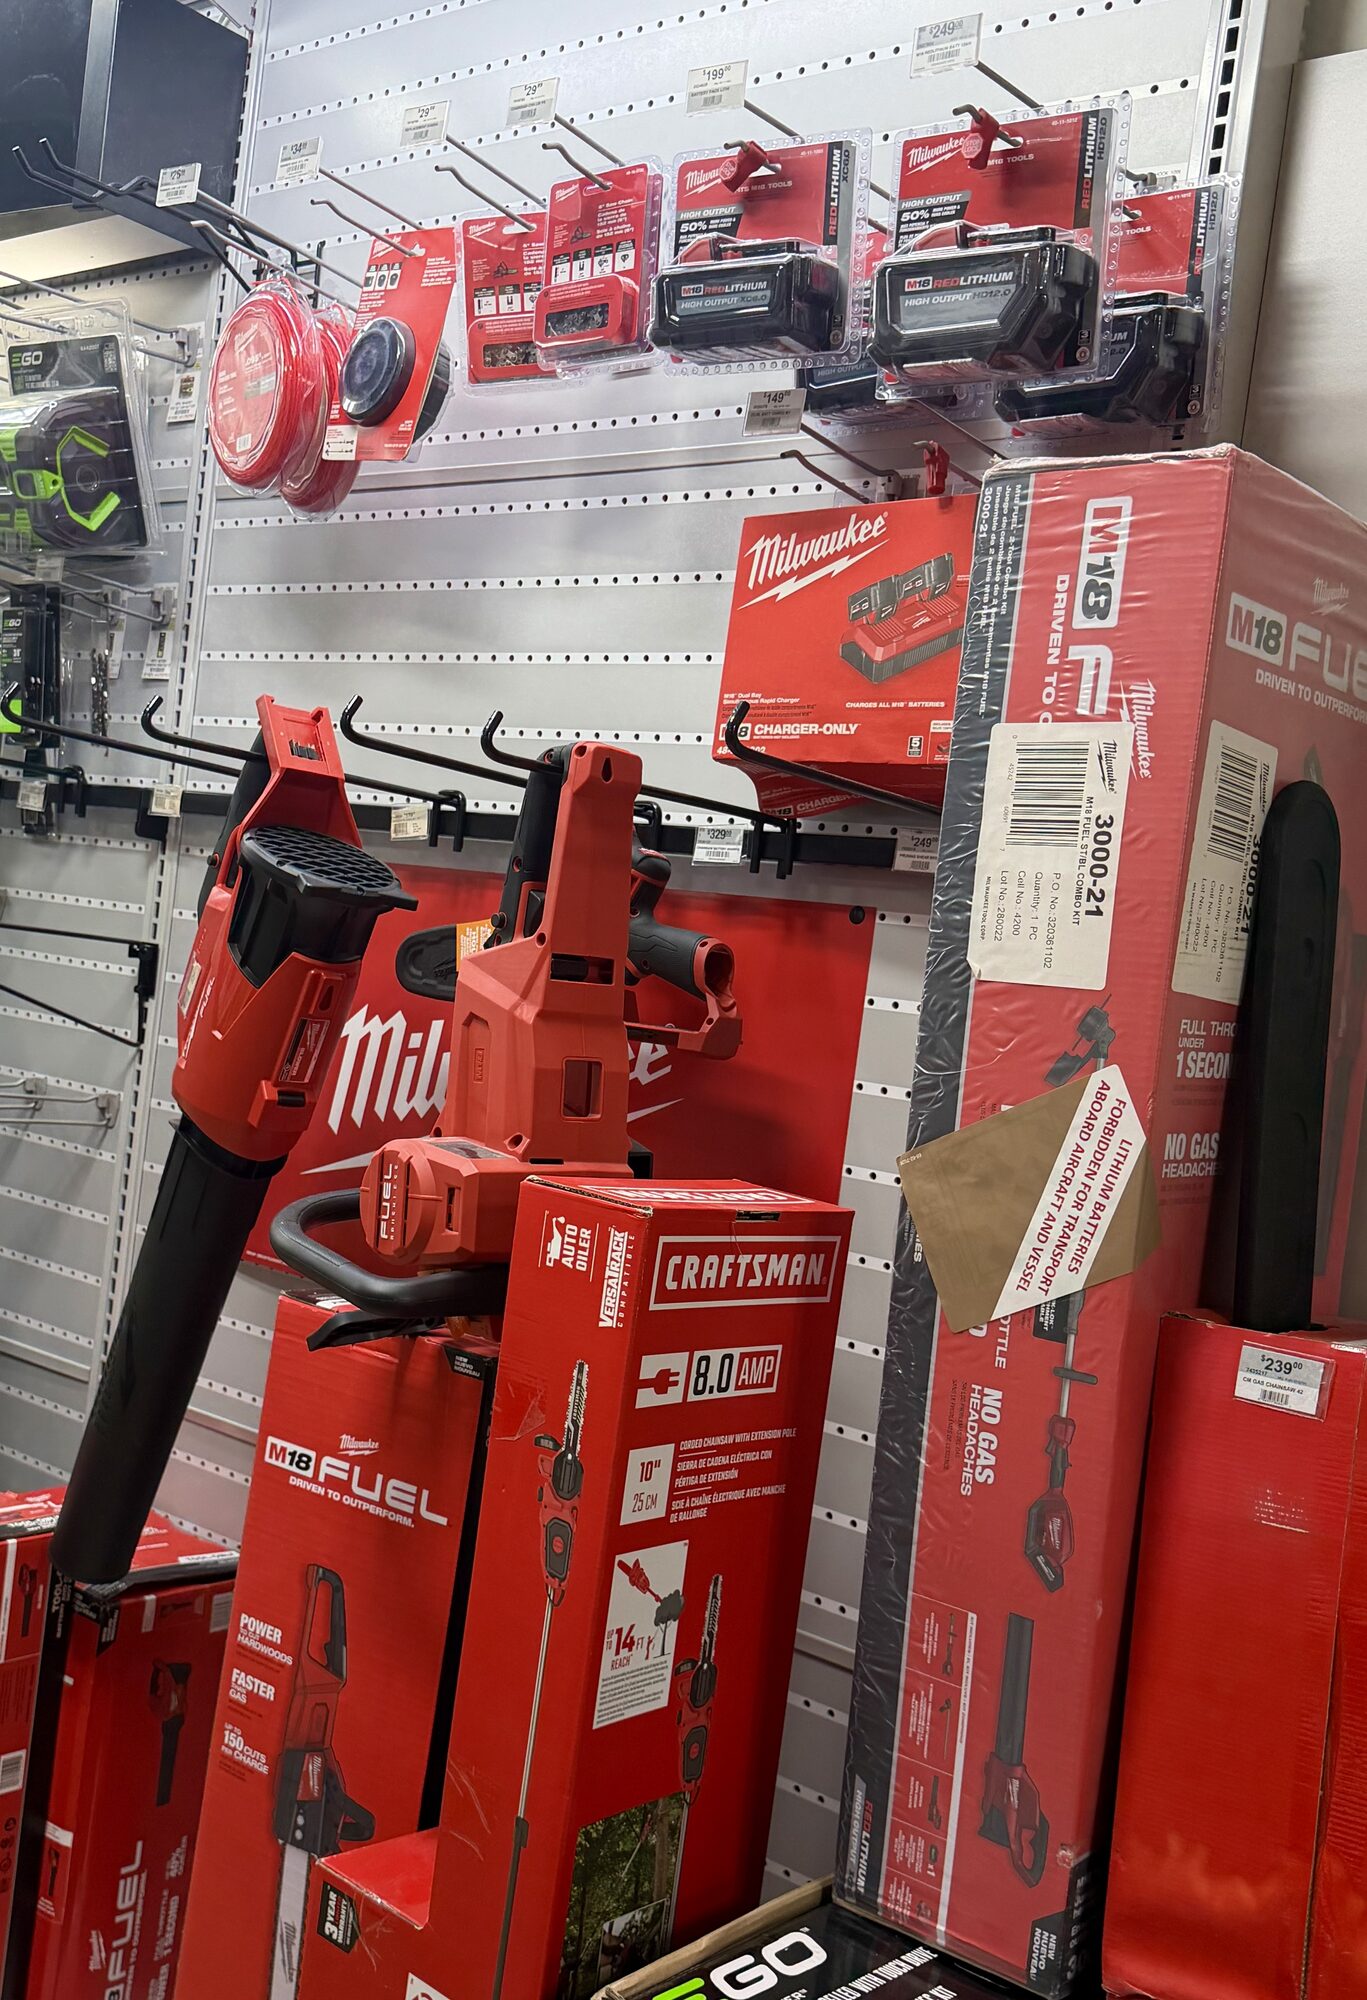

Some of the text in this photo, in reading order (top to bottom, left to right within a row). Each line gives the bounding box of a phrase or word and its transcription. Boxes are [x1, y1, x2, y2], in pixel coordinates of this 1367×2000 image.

[1007, 154, 1034, 163] TOOLS
[1081, 117, 1098, 209] REDLITHIUM
[768, 180, 793, 189] TOOLS
[829, 148, 841, 235] REDLITHIUM
[901, 193, 962, 209] HIGH OUTPUT
[680, 206, 736, 219] HIGH OUTPUT
[680, 221, 708, 232] 50%
[901, 210, 929, 221] 50%
[1126, 226, 1152, 236] TOOLS
[1193, 191, 1210, 276] REDLITHIUM
[703, 281, 767, 296] REDLITHIUM
[907, 272, 1013, 290] M18 REDLITHIUM
[681, 297, 738, 309] HIGH OUTPUT
[905, 297, 930, 307] HIGH
[932, 293, 971, 305] OUTPUT
[11, 351, 43, 368] EGO
[978, 486, 993, 539] 3000-21
[1002, 485, 1012, 515] Juego
[985, 486, 1003, 583] Ensemble outils
[1001, 516, 1009, 529] de
[744, 513, 888, 591] Milwaukee
[996, 531, 1007, 582] combinado
[1081, 505, 1124, 621] M18
[1000, 536, 1016, 615] 2-Tool Combo Kit
[1042, 574, 1070, 705] DRIVEN TO
[1230, 604, 1283, 656] M18
[1255, 668, 1312, 702] DRIVEN TO
[754, 723, 858, 736] CHARGER-ONLY
[1130, 678, 1157, 779] Milwaukee
[1103, 739, 1117, 794] Milwaukee
[1000, 870, 1009, 885] Lot
[1072, 796, 1094, 926] M18 FUEL ST/BL COMBO KIT
[1086, 814, 1114, 917] 3000-21
[1011, 870, 1027, 936] Cell 4200
[1028, 871, 1044, 941] Quantity: PC
[1236, 889, 1246, 925] COMBO
[1178, 1037, 1204, 1049] UNDER
[1180, 1019, 1207, 1036] FULL
[1176, 1051, 1185, 1078] 1
[1083, 1097, 1128, 1181] FORBIDDEN
[1164, 1132, 1220, 1160] NO GAS
[380, 1163, 393, 1240] FUEL
[1016, 1080, 1112, 1293] ABOARD AIRCRAFT AND VESSEL
[1071, 1182, 1093, 1213] FOR
[1067, 1139, 1134, 1276] LITHIUM BATTERIES
[561, 1224, 578, 1270] AUTO
[575, 1227, 592, 1272] OILER
[1038, 1212, 1080, 1296] TRANSPORT
[599, 1228, 629, 1328] VERSATRACK
[617, 1234, 635, 1328] COMPATIBLE
[665, 1253, 825, 1291] CRAFTSMAN
[693, 1352, 775, 1397] 8.0 AMP
[1252, 1378, 1296, 1394] GAS CHAINSAW
[338, 1434, 380, 1450] Milwaukee
[679, 1428, 797, 1451] CORDED CHAINSAW WITH EXTENSION POLE
[960, 1384, 983, 1497] HEADACHES
[975, 1386, 1003, 1485] NO GAS
[676, 1459, 698, 1472] SIERRA
[706, 1454, 729, 1468] CADENA
[760, 1449, 773, 1460] CON
[267, 1442, 448, 1526] M18 FUEL
[289, 1475, 325, 1496] DRIVEN
[327, 1488, 341, 1502] TO
[671, 1498, 685, 1511] SCIE
[745, 1486, 762, 1498] AVEC
[762, 1484, 786, 1496] MANCHE
[632, 1492, 658, 1513] 25 CM
[678, 1508, 708, 1521] RALLONGE
[239, 1613, 283, 1644] POWER
[614, 1623, 645, 1657] 14 FT
[237, 1634, 293, 1666] HARDWOODS
[229, 1689, 247, 1705] GAS
[231, 1668, 276, 1701] FASTER
[223, 1729, 267, 1764] 150 CUTS
[234, 1751, 270, 1775] CHARGE
[848, 1789, 863, 1866] HIGH OUTPUT
[855, 1799, 873, 1894] REDLITHIUM
[107, 1839, 144, 1982] FUEL
[324, 1890, 341, 1941] 3 YEAR
[338, 1899, 349, 1944] WARRANTY
[1030, 1928, 1041, 1983] NOUVEAU
[1038, 1929, 1049, 1971] NUEVO
[1047, 1932, 1056, 1961] NEW
[848, 1972, 887, 1994] WITH
[872, 1958, 915, 1981] TOUCH
[900, 1945, 939, 1968] DRIVE
[929, 1985, 958, 2000] KIT
